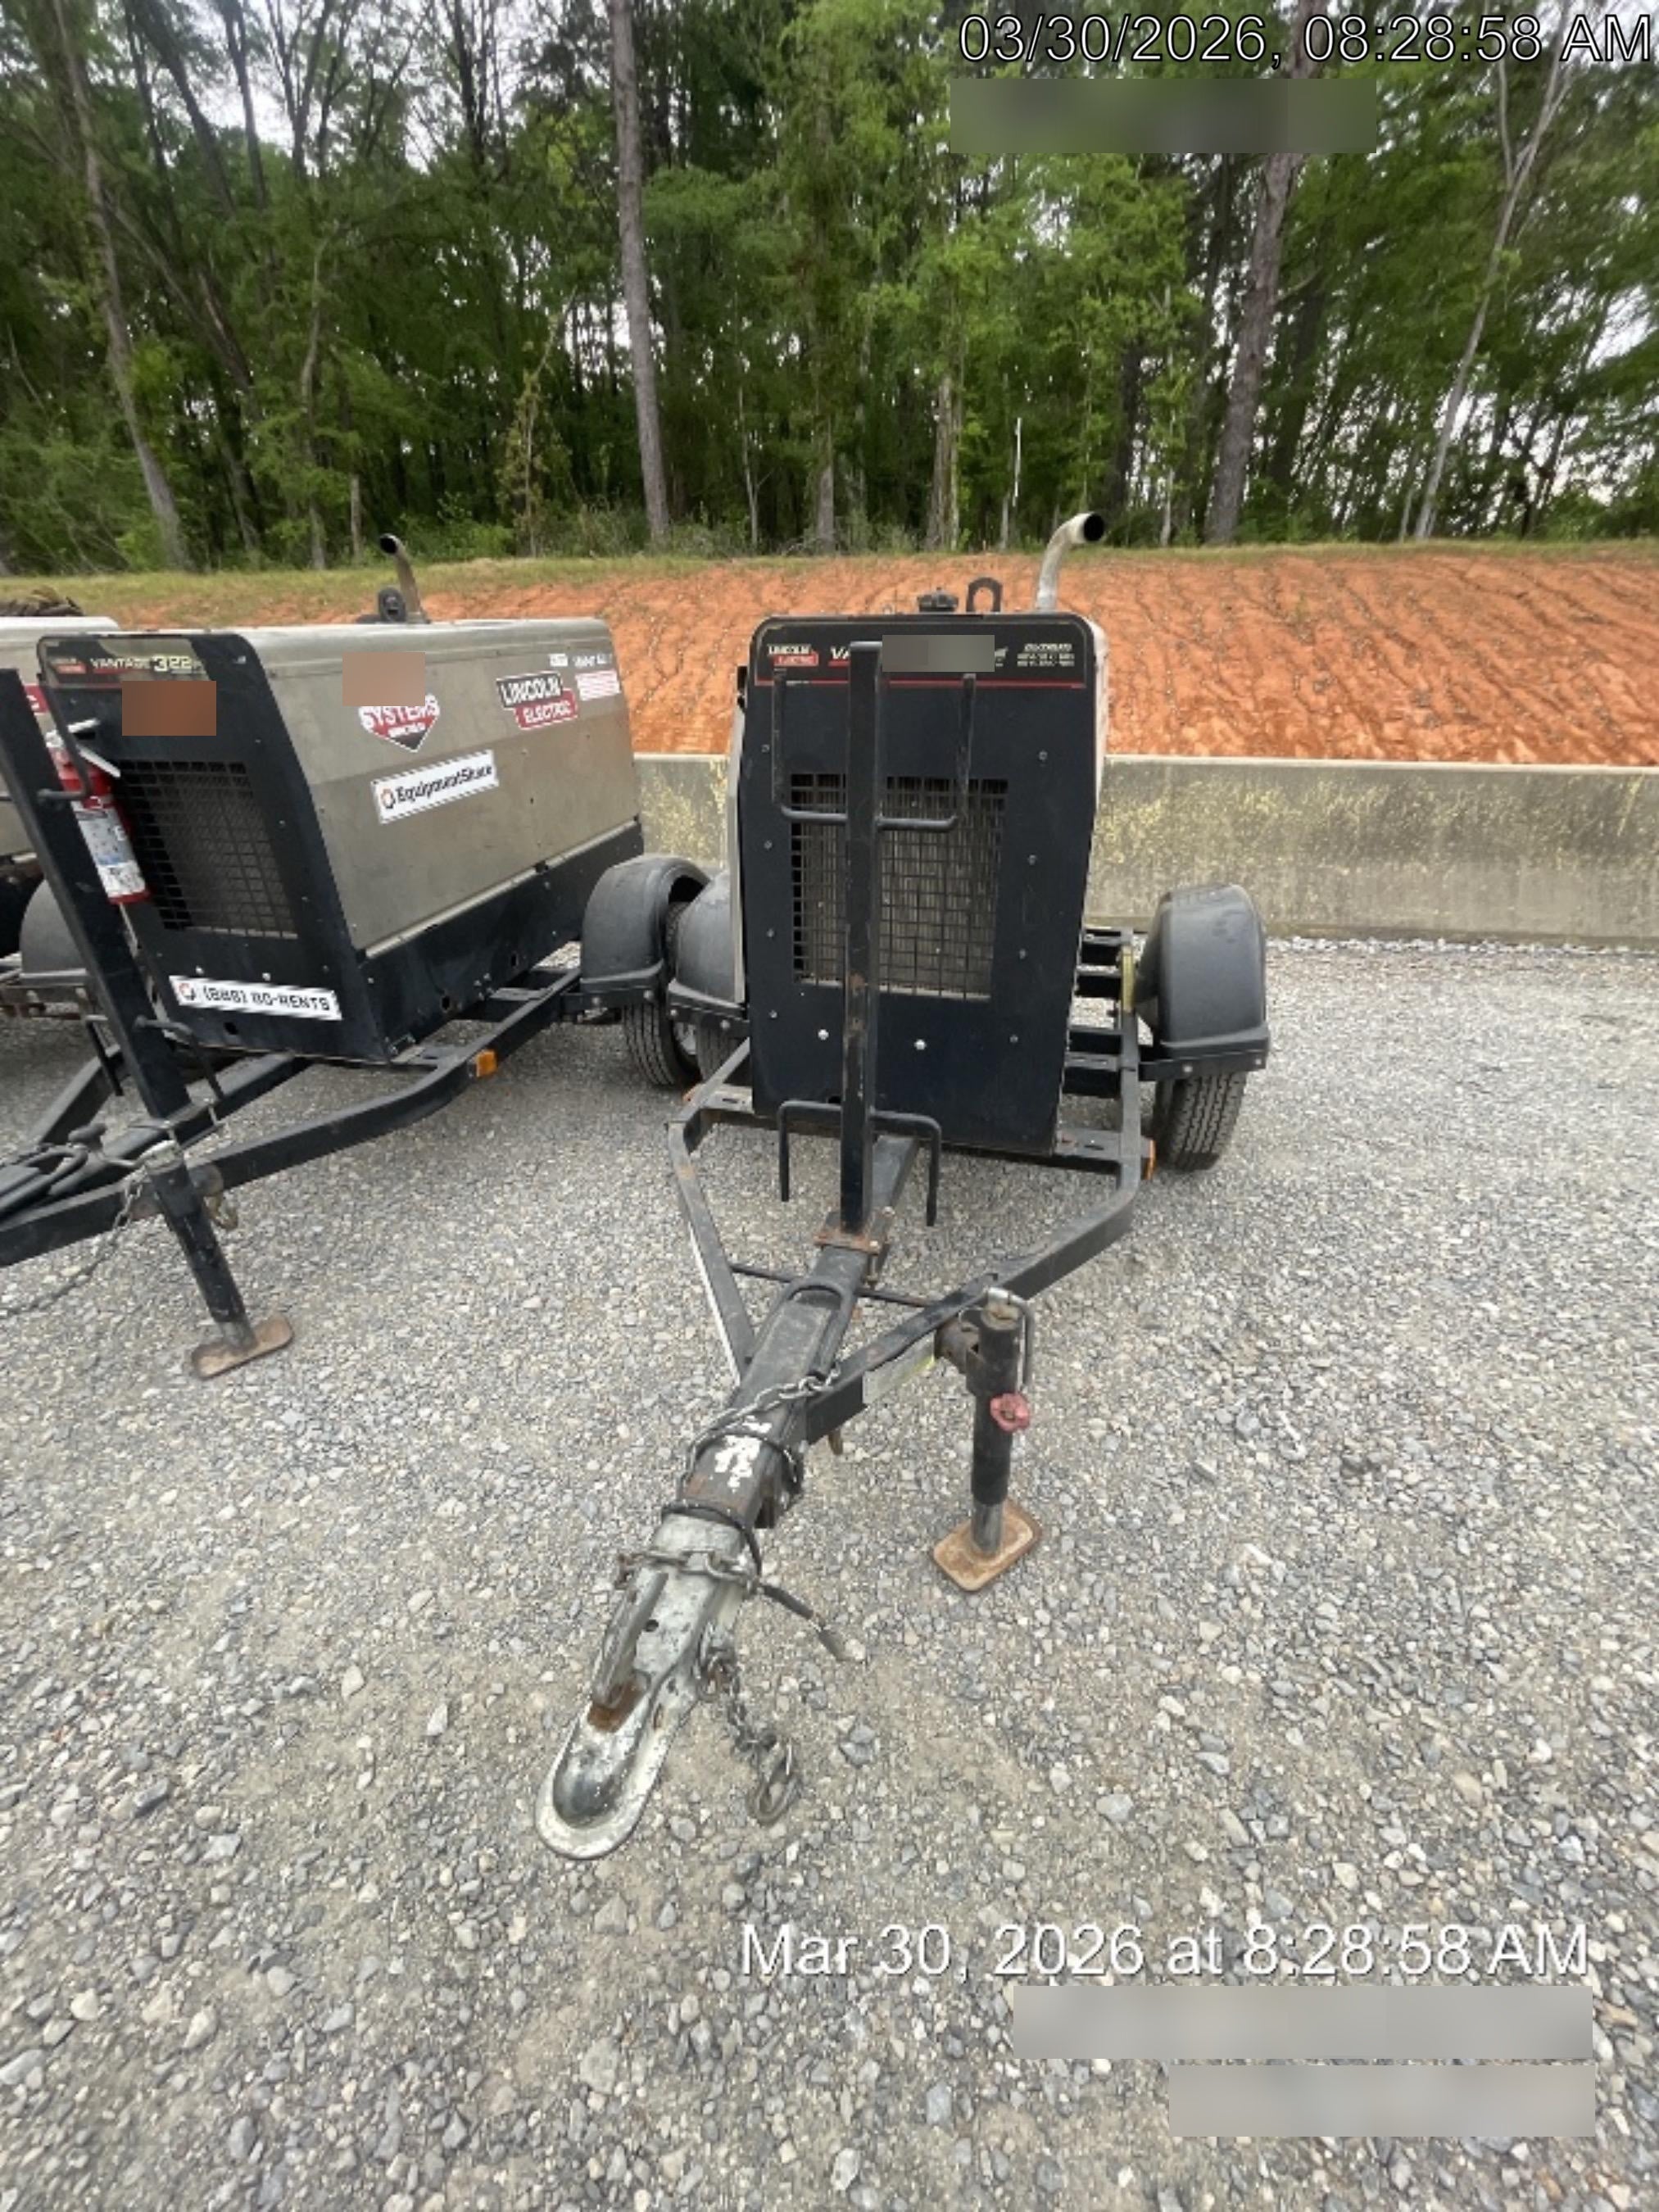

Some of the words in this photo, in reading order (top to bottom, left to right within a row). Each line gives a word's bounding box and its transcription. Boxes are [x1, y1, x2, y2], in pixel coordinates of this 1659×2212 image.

[501, 675, 561, 706] LINCOLN
[523, 699, 572, 724] ELECTRIC
[395, 765, 492, 802] EquipmentShare
